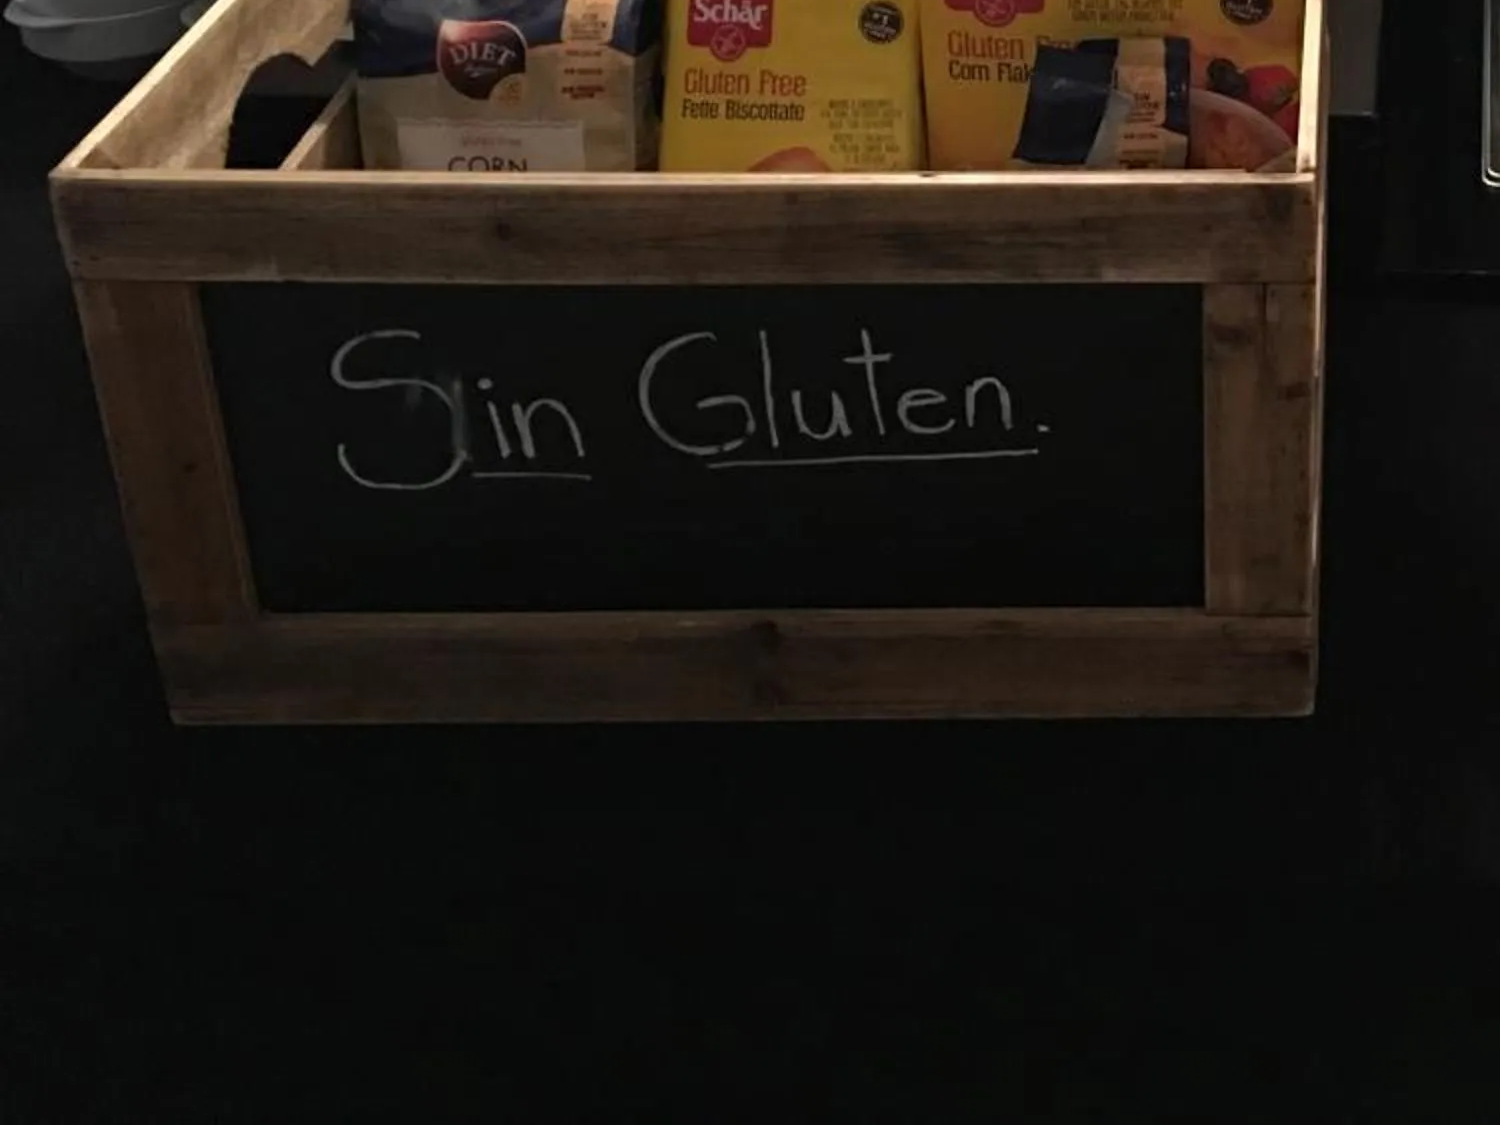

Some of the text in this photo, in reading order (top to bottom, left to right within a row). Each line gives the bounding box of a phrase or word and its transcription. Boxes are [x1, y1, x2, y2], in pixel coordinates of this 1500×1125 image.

[448, 41, 517, 67] DIET
[947, 30, 1024, 60] Gluten
[684, 67, 807, 97] Gluten Free
[681, 98, 720, 119] Fette
[725, 99, 806, 121] Biscottate
[331, 328, 1049, 489] Sin Gluten.
